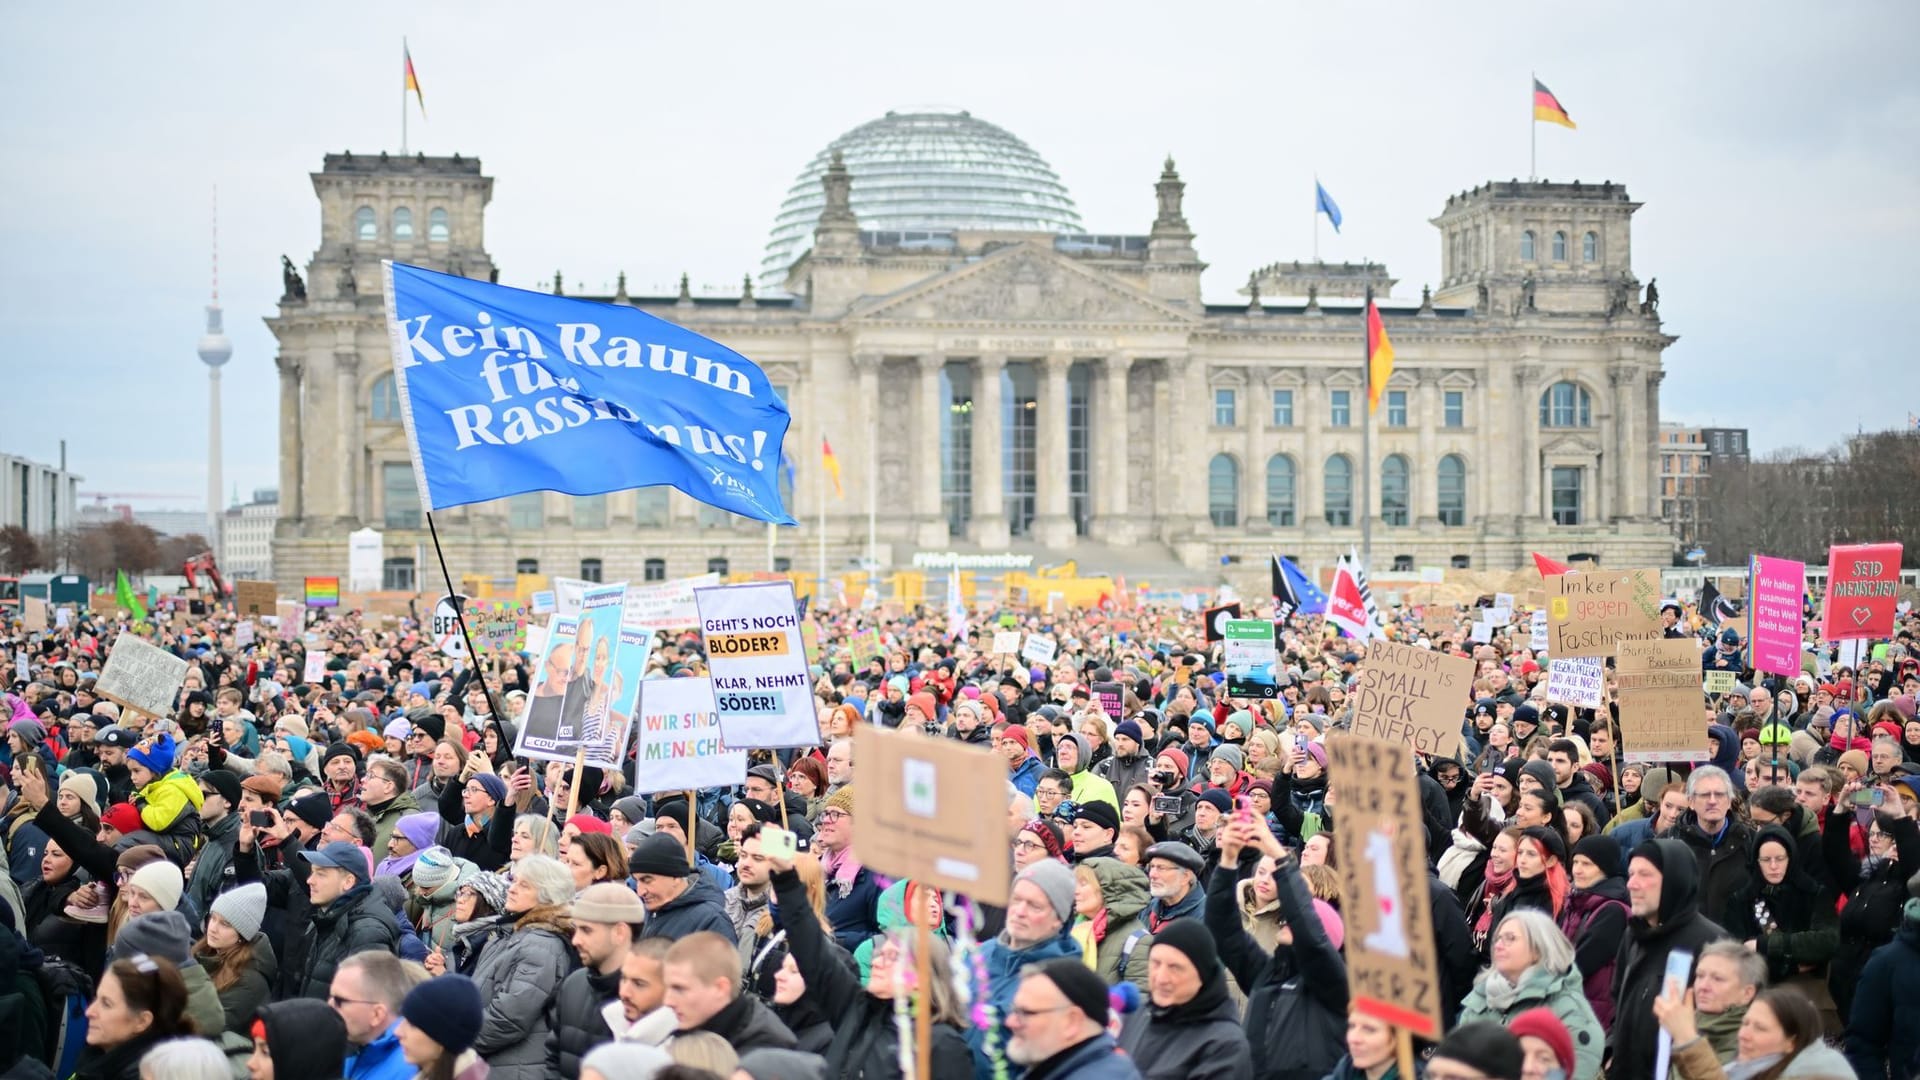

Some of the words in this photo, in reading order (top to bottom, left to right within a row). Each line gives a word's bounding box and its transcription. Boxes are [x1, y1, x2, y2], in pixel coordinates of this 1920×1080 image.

[396, 311, 547, 368] Kein
[556, 322, 754, 398] Raum
[1852, 561, 1883, 577] SEID
[1561, 575, 1617, 596] Imker
[1760, 577, 1772, 588] Wir
[1773, 578, 1796, 592] halten
[1833, 580, 1898, 598] MENSCHEN
[1576, 600, 1629, 621] gegen
[1781, 609, 1798, 621] Welt
[706, 617, 749, 632] GEHT'S
[753, 615, 797, 630] NOCH
[1758, 618, 1777, 631] bleibt
[1778, 622, 1797, 635] bunt.
[709, 635, 779, 653] BLÖDER?
[1372, 642, 1439, 672] RACISM
[1438, 672, 1456, 687] IS
[715, 677, 752, 690] KLAR,
[756, 674, 806, 688] NEHMT
[1365, 669, 1430, 699] SMALL
[719, 693, 776, 711] SÖDER!
[1360, 688, 1416, 721] DICK
[646, 714, 678, 731] WIR
[683, 711, 718, 728] SIND
[1355, 713, 1446, 753] ENERGY
[534, 739, 556, 749] CDU
[645, 738, 727, 760] MENSCHE
